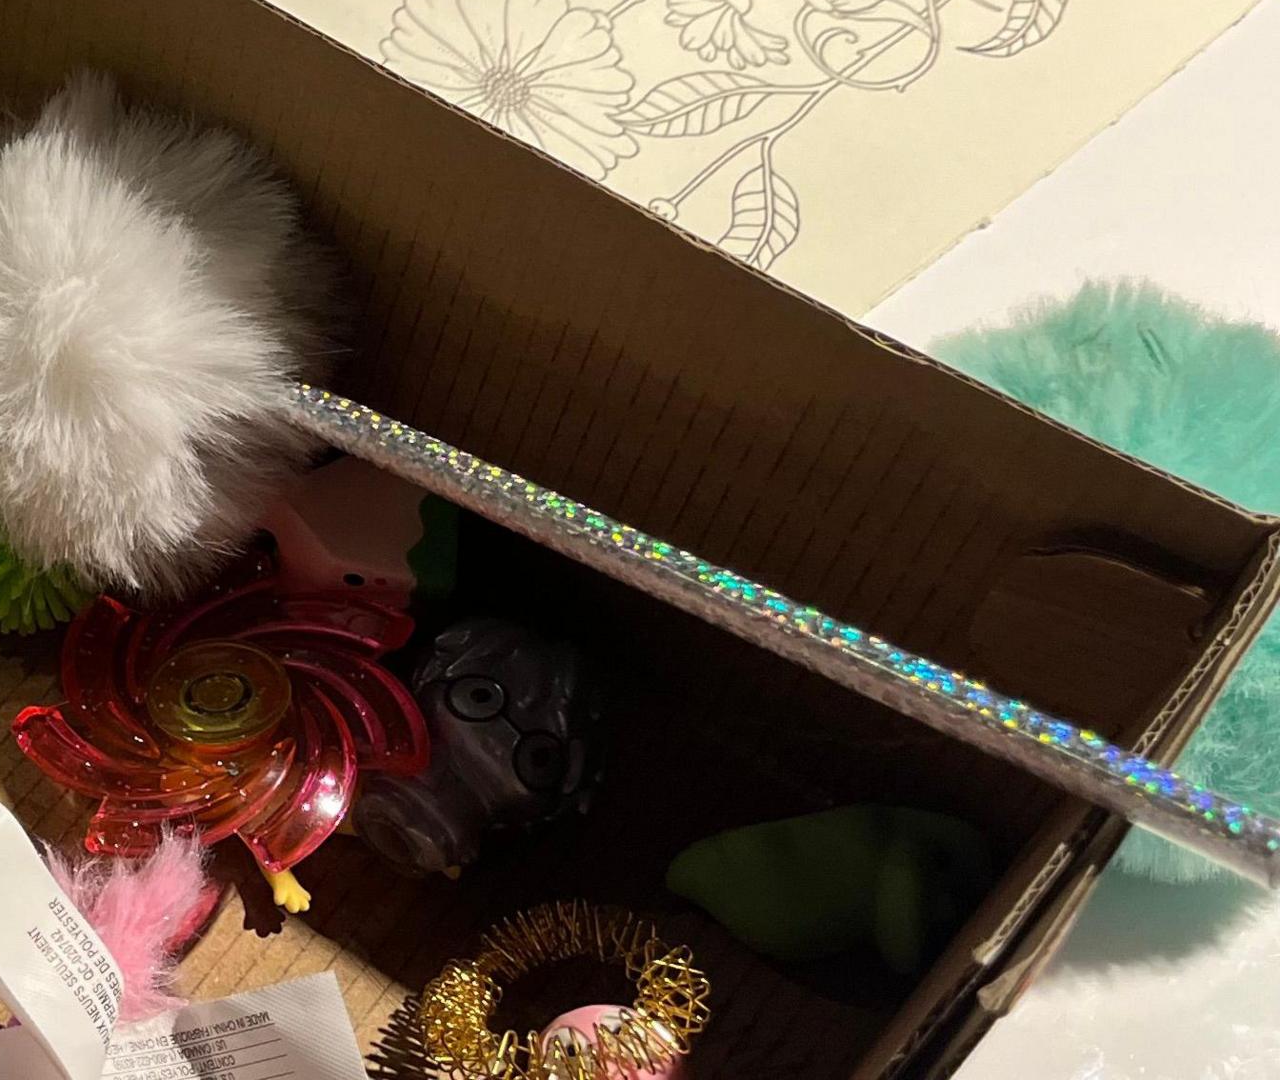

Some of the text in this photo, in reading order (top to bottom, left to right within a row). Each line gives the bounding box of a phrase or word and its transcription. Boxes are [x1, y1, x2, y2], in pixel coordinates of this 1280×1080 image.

[48, 898, 96, 958] POLYESTER
[27, 927, 78, 988] SEULEMENT
[94, 956, 110, 975] DE
[74, 986, 101, 1024] NEUFS
[235, 1018, 245, 1029] IN
[247, 1011, 271, 1027] MADE
[215, 1021, 236, 1035] CHINA
[131, 1039, 155, 1053] CHINE
[156, 1037, 169, 1047] EN
[180, 1043, 213, 1058] CANADA
